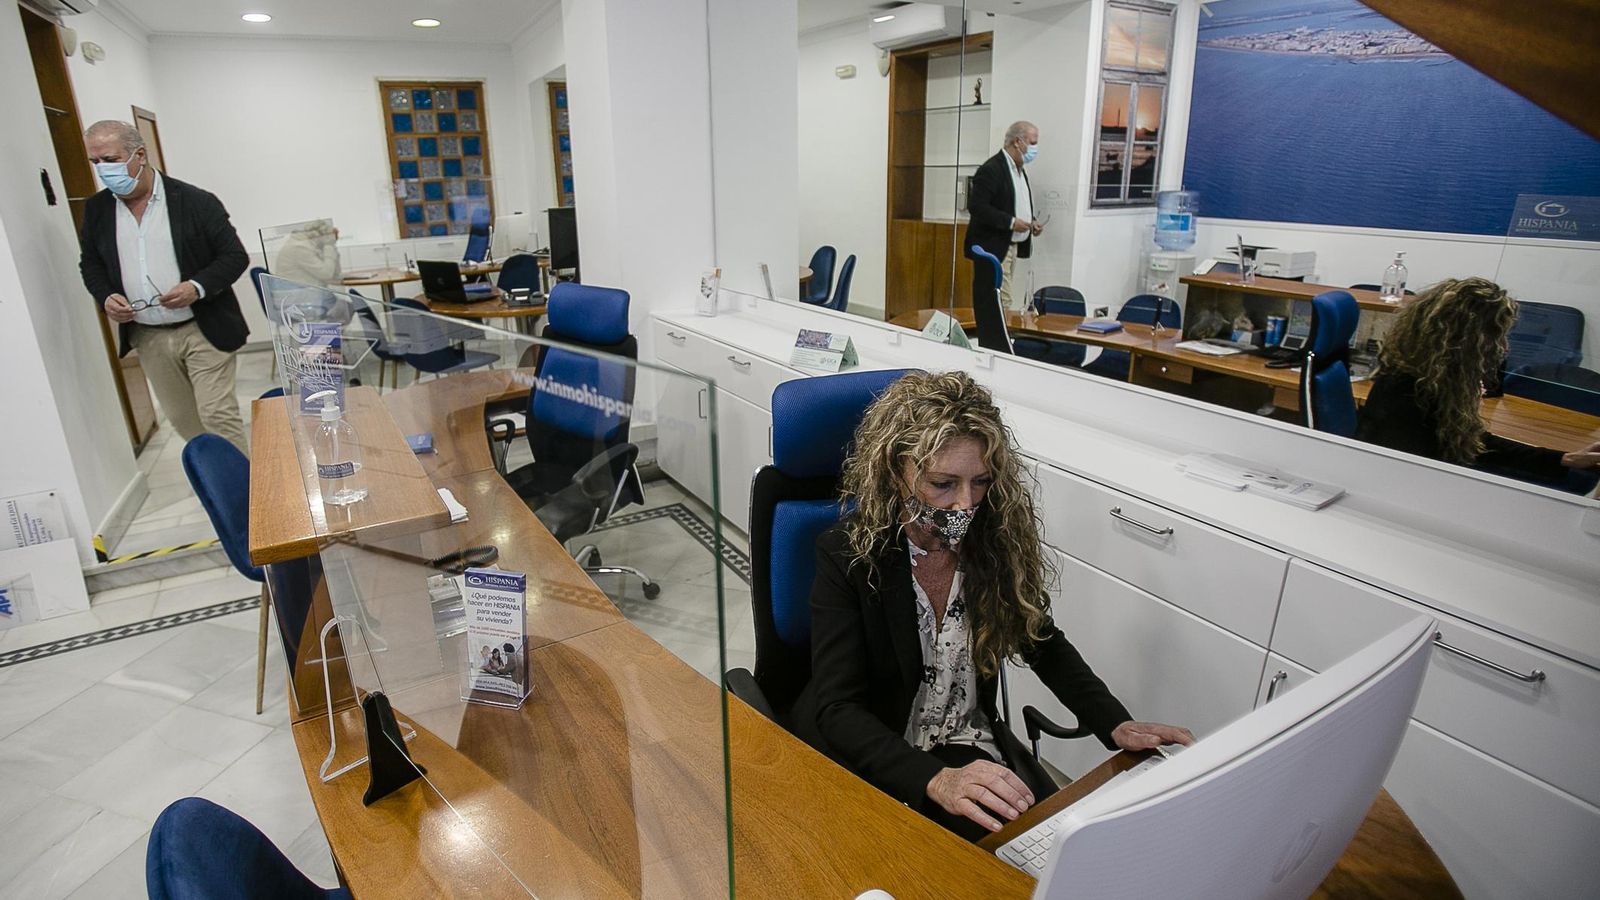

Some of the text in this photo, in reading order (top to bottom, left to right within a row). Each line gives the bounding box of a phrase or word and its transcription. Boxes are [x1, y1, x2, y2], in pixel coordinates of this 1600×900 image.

[1518, 218, 1577, 230] HISPANIA
[325, 463, 353, 472] HISPANIA
[485, 576, 519, 587] HISPANIA
[471, 592, 516, 603] ¿Qué podemos
[468, 599, 483, 607] hacer
[494, 602, 520, 611] HISPANIA
[486, 617, 512, 625] vivienda?
